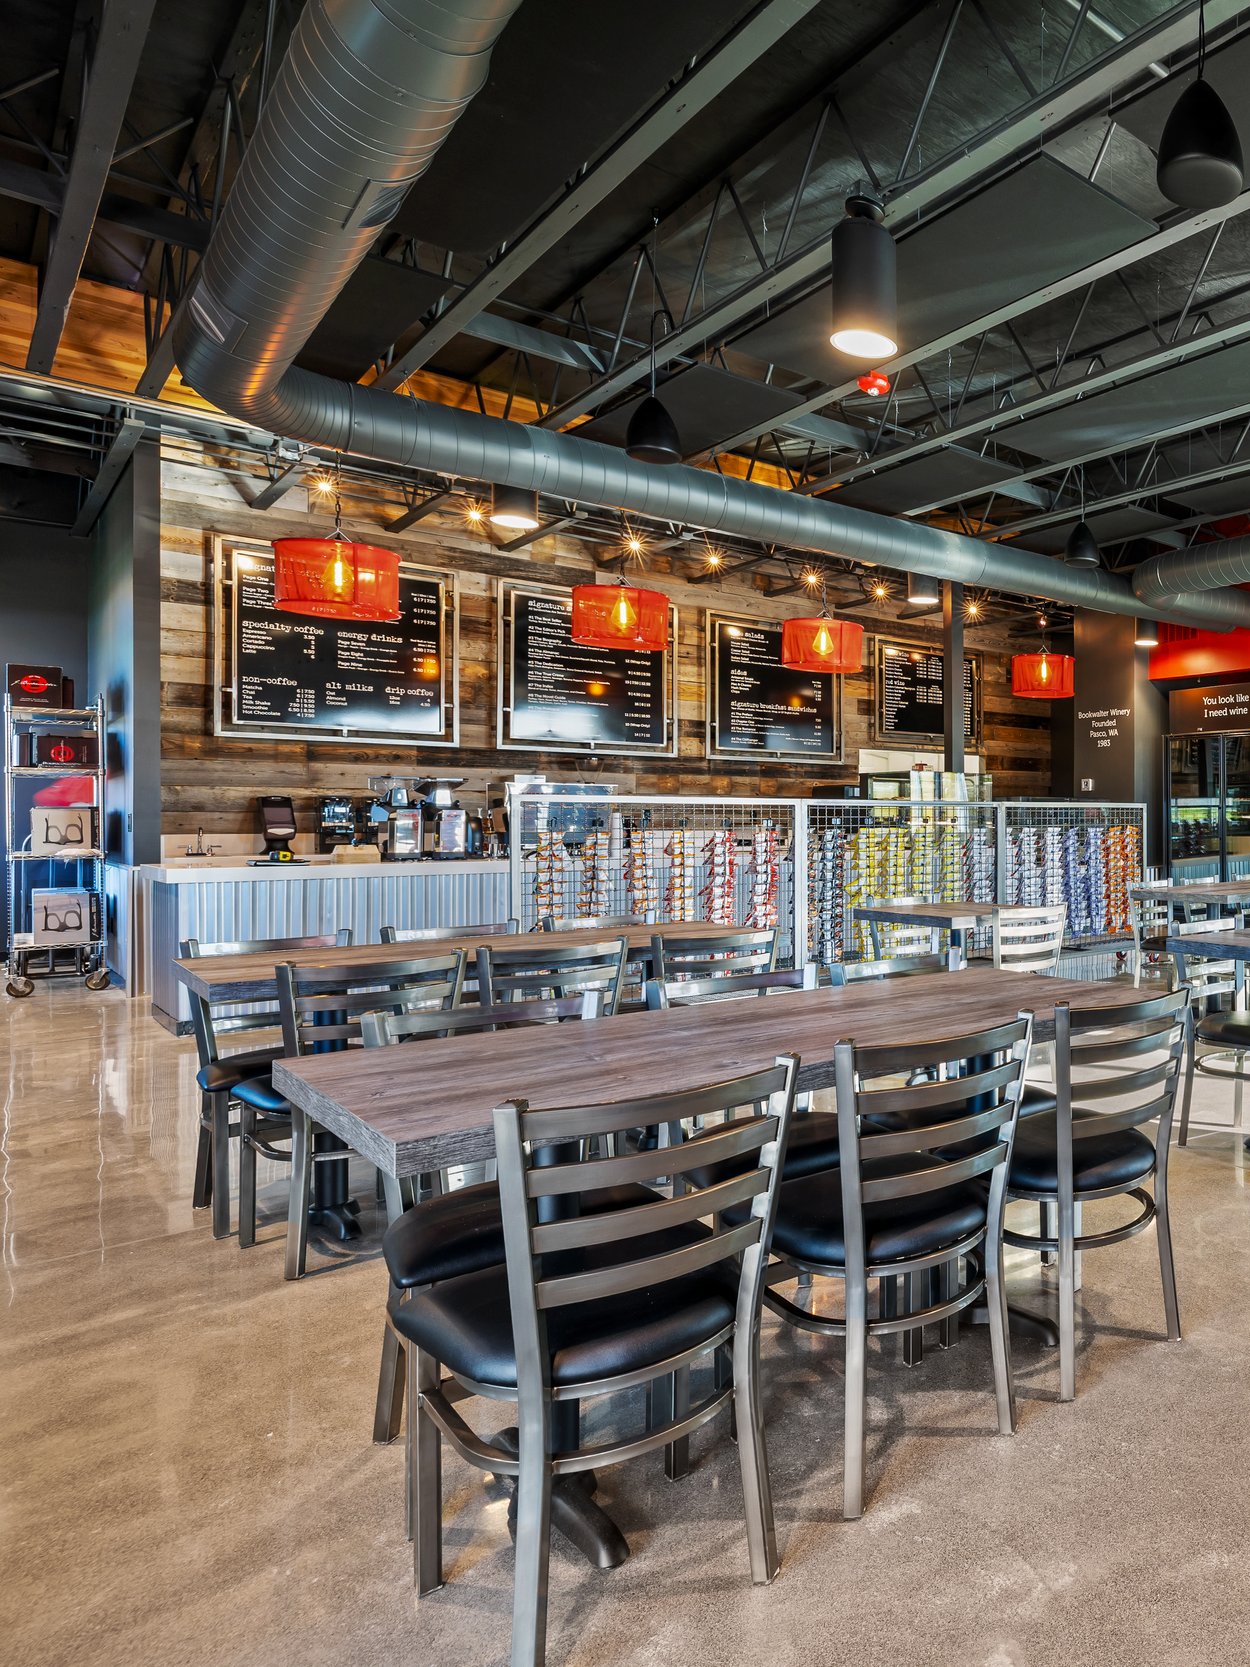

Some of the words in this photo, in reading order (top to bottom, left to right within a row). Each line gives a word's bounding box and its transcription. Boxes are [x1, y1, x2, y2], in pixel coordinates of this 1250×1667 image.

[527, 599, 565, 611] signature
[242, 620, 292, 633] specialty
[293, 625, 324, 635] coffee
[337, 631, 369, 641] energy
[370, 633, 403, 644] drinks
[325, 681, 342, 690] alt
[345, 683, 374, 692] milks
[384, 686, 406, 696] drip
[407, 688, 434, 697] coffee
[1202, 696, 1218, 706] You
[1218, 694, 1235, 705] look
[1235, 693, 1250, 703] like
[1078, 709, 1109, 719] Bookwalter
[1109, 708, 1131, 717] Winery
[1204, 709, 1209, 718] I
[1209, 708, 1228, 718] need
[1228, 706, 1248, 717] wine
[1091, 719, 1117, 728] Founded
[1108, 729, 1119, 737] WA
